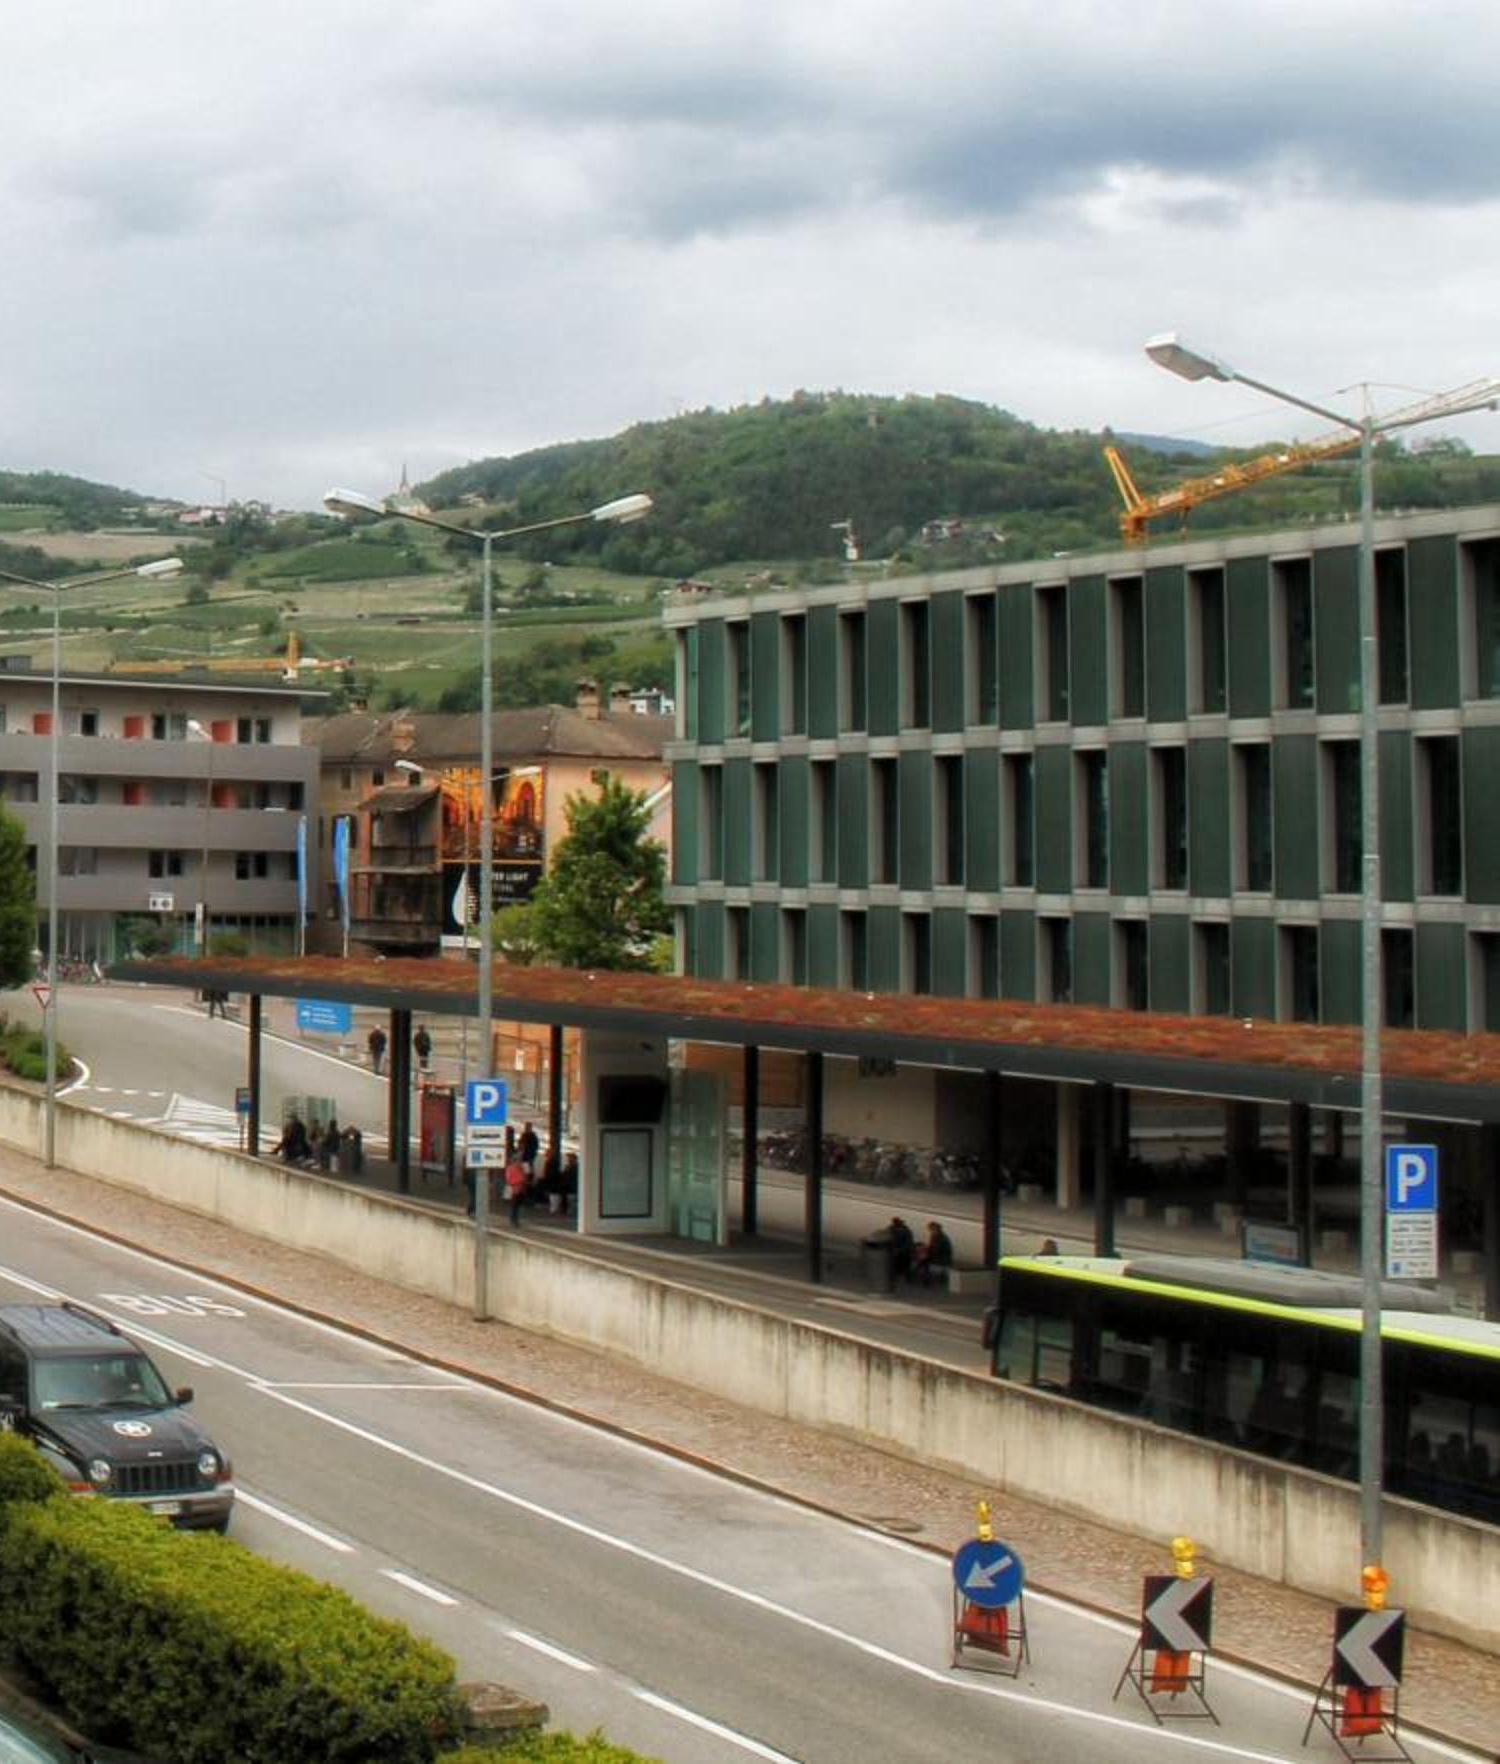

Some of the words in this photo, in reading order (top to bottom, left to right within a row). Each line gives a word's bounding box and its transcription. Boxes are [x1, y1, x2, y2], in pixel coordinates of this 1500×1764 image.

[473, 1085, 499, 1119] P
[1397, 1153, 1427, 1203] P
[97, 1293, 247, 1318] BUS
